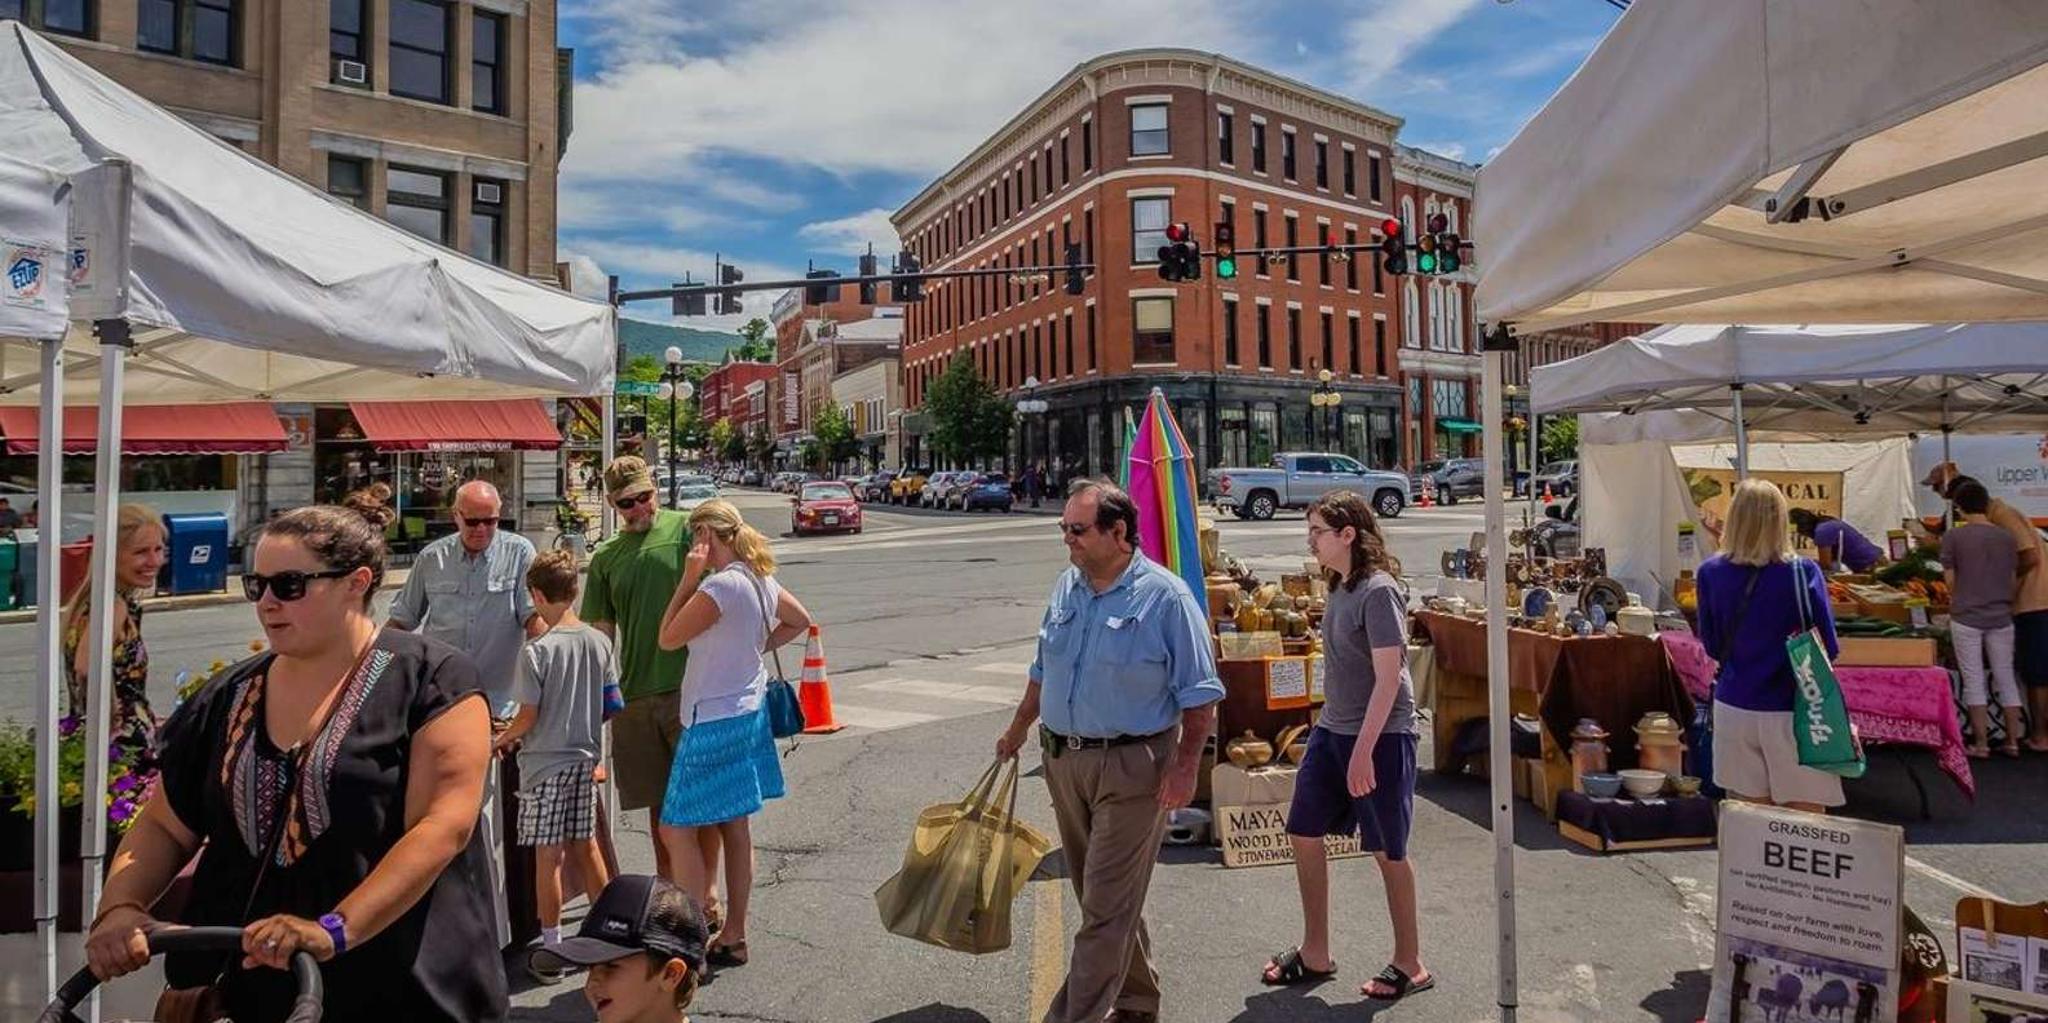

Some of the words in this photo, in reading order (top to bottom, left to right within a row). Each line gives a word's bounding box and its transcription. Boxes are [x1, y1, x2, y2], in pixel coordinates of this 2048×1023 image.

[1996, 466, 2037, 485] Upper
[1229, 809, 1285, 832] MAYA
[1228, 835, 1271, 850] WOOD
[1768, 821, 1850, 845] GRASSFED
[1238, 848, 1295, 864] STONEWAR
[1763, 841, 1854, 879] BEEF
[1732, 900, 1767, 916] Raised
[1769, 909, 1783, 919] on
[1786, 912, 1804, 923] our
[1805, 916, 1830, 928] farm
[1832, 922, 1856, 934] with
[1731, 914, 1769, 929] respect
[1771, 921, 1791, 933] and
[1793, 926, 1837, 943] freedom
[1840, 936, 1850, 946] to
